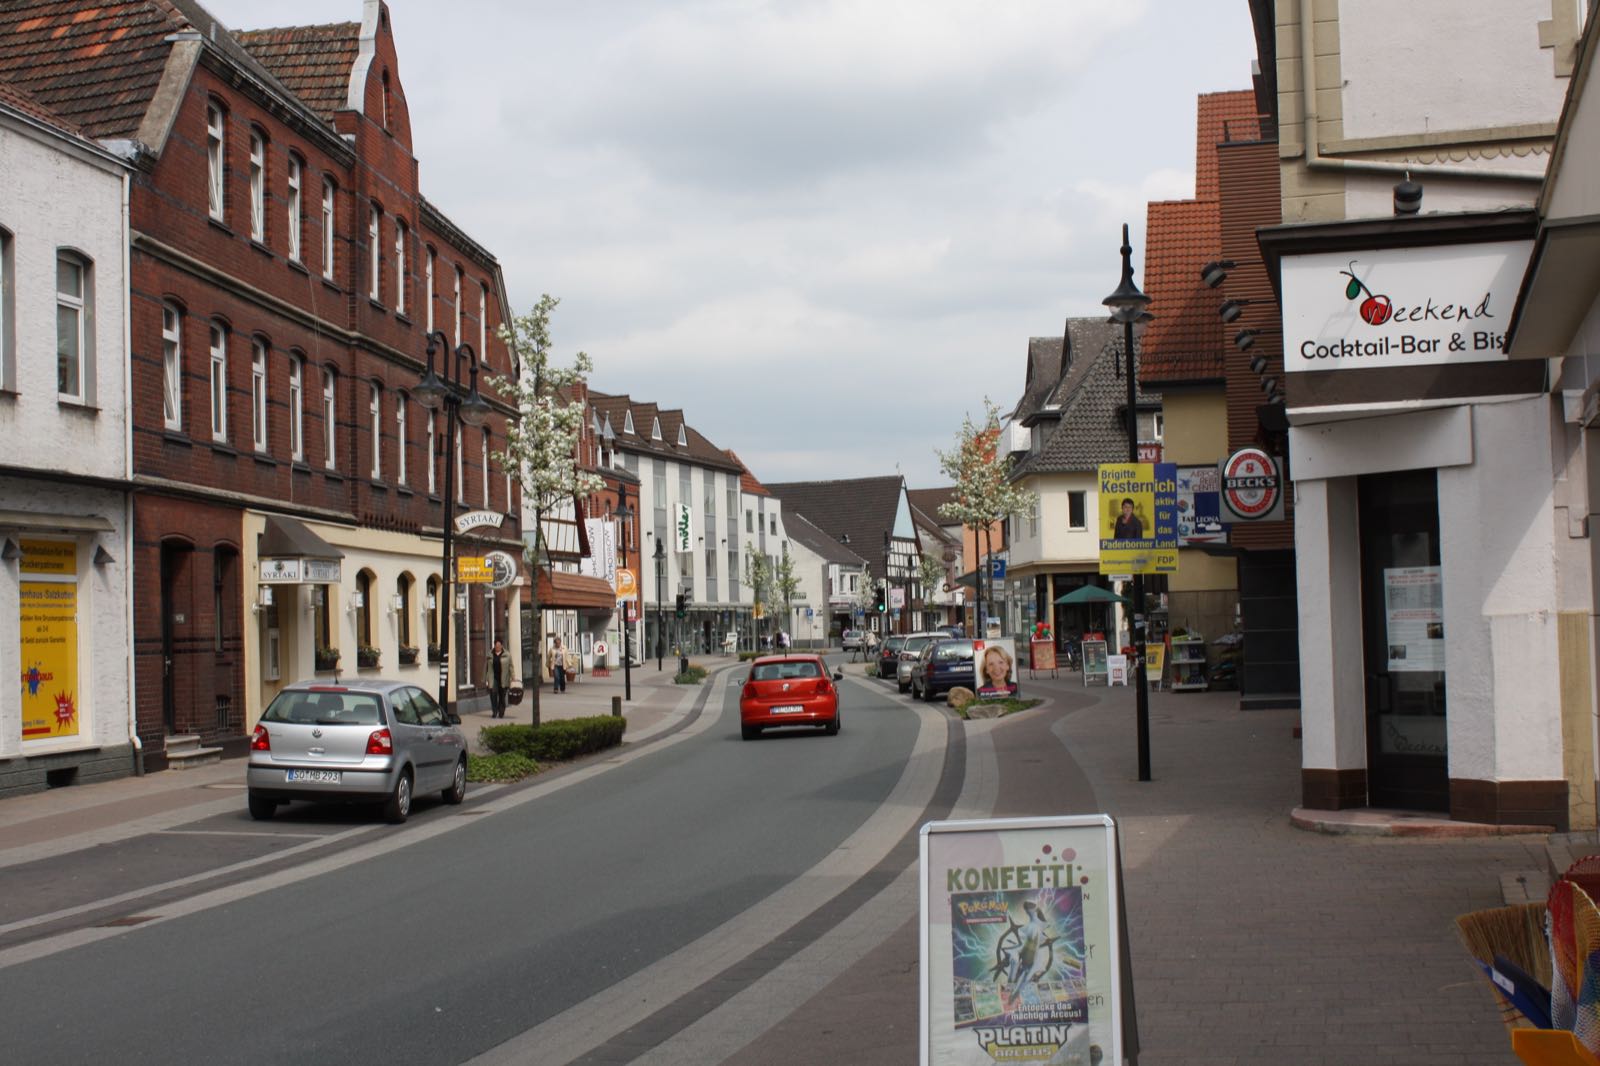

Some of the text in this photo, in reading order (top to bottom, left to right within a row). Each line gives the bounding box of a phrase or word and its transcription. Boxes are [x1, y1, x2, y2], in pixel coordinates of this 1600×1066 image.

[1369, 292, 1495, 325] Weekend
[1300, 335, 1440, 359] Cocktail-Bar
[1448, 333, 1466, 351] &
[1101, 469, 1136, 480] Brigitte
[1101, 479, 1175, 493] Kesternich
[1155, 497, 1175, 506] aktiv
[459, 513, 500, 529] SYRTAKI
[1159, 511, 1171, 520] für
[1157, 525, 1172, 534] das
[1102, 539, 1176, 549] Paderborner Land
[1157, 555, 1175, 564] FDP
[263, 570, 297, 579] SYRTAKI
[947, 864, 1074, 892] KONFETTI
[1017, 1002, 1072, 1012] Entdecke das
[1011, 1010, 1082, 1021] mächtige Arceus!
[974, 1022, 1072, 1049] PLATIN
